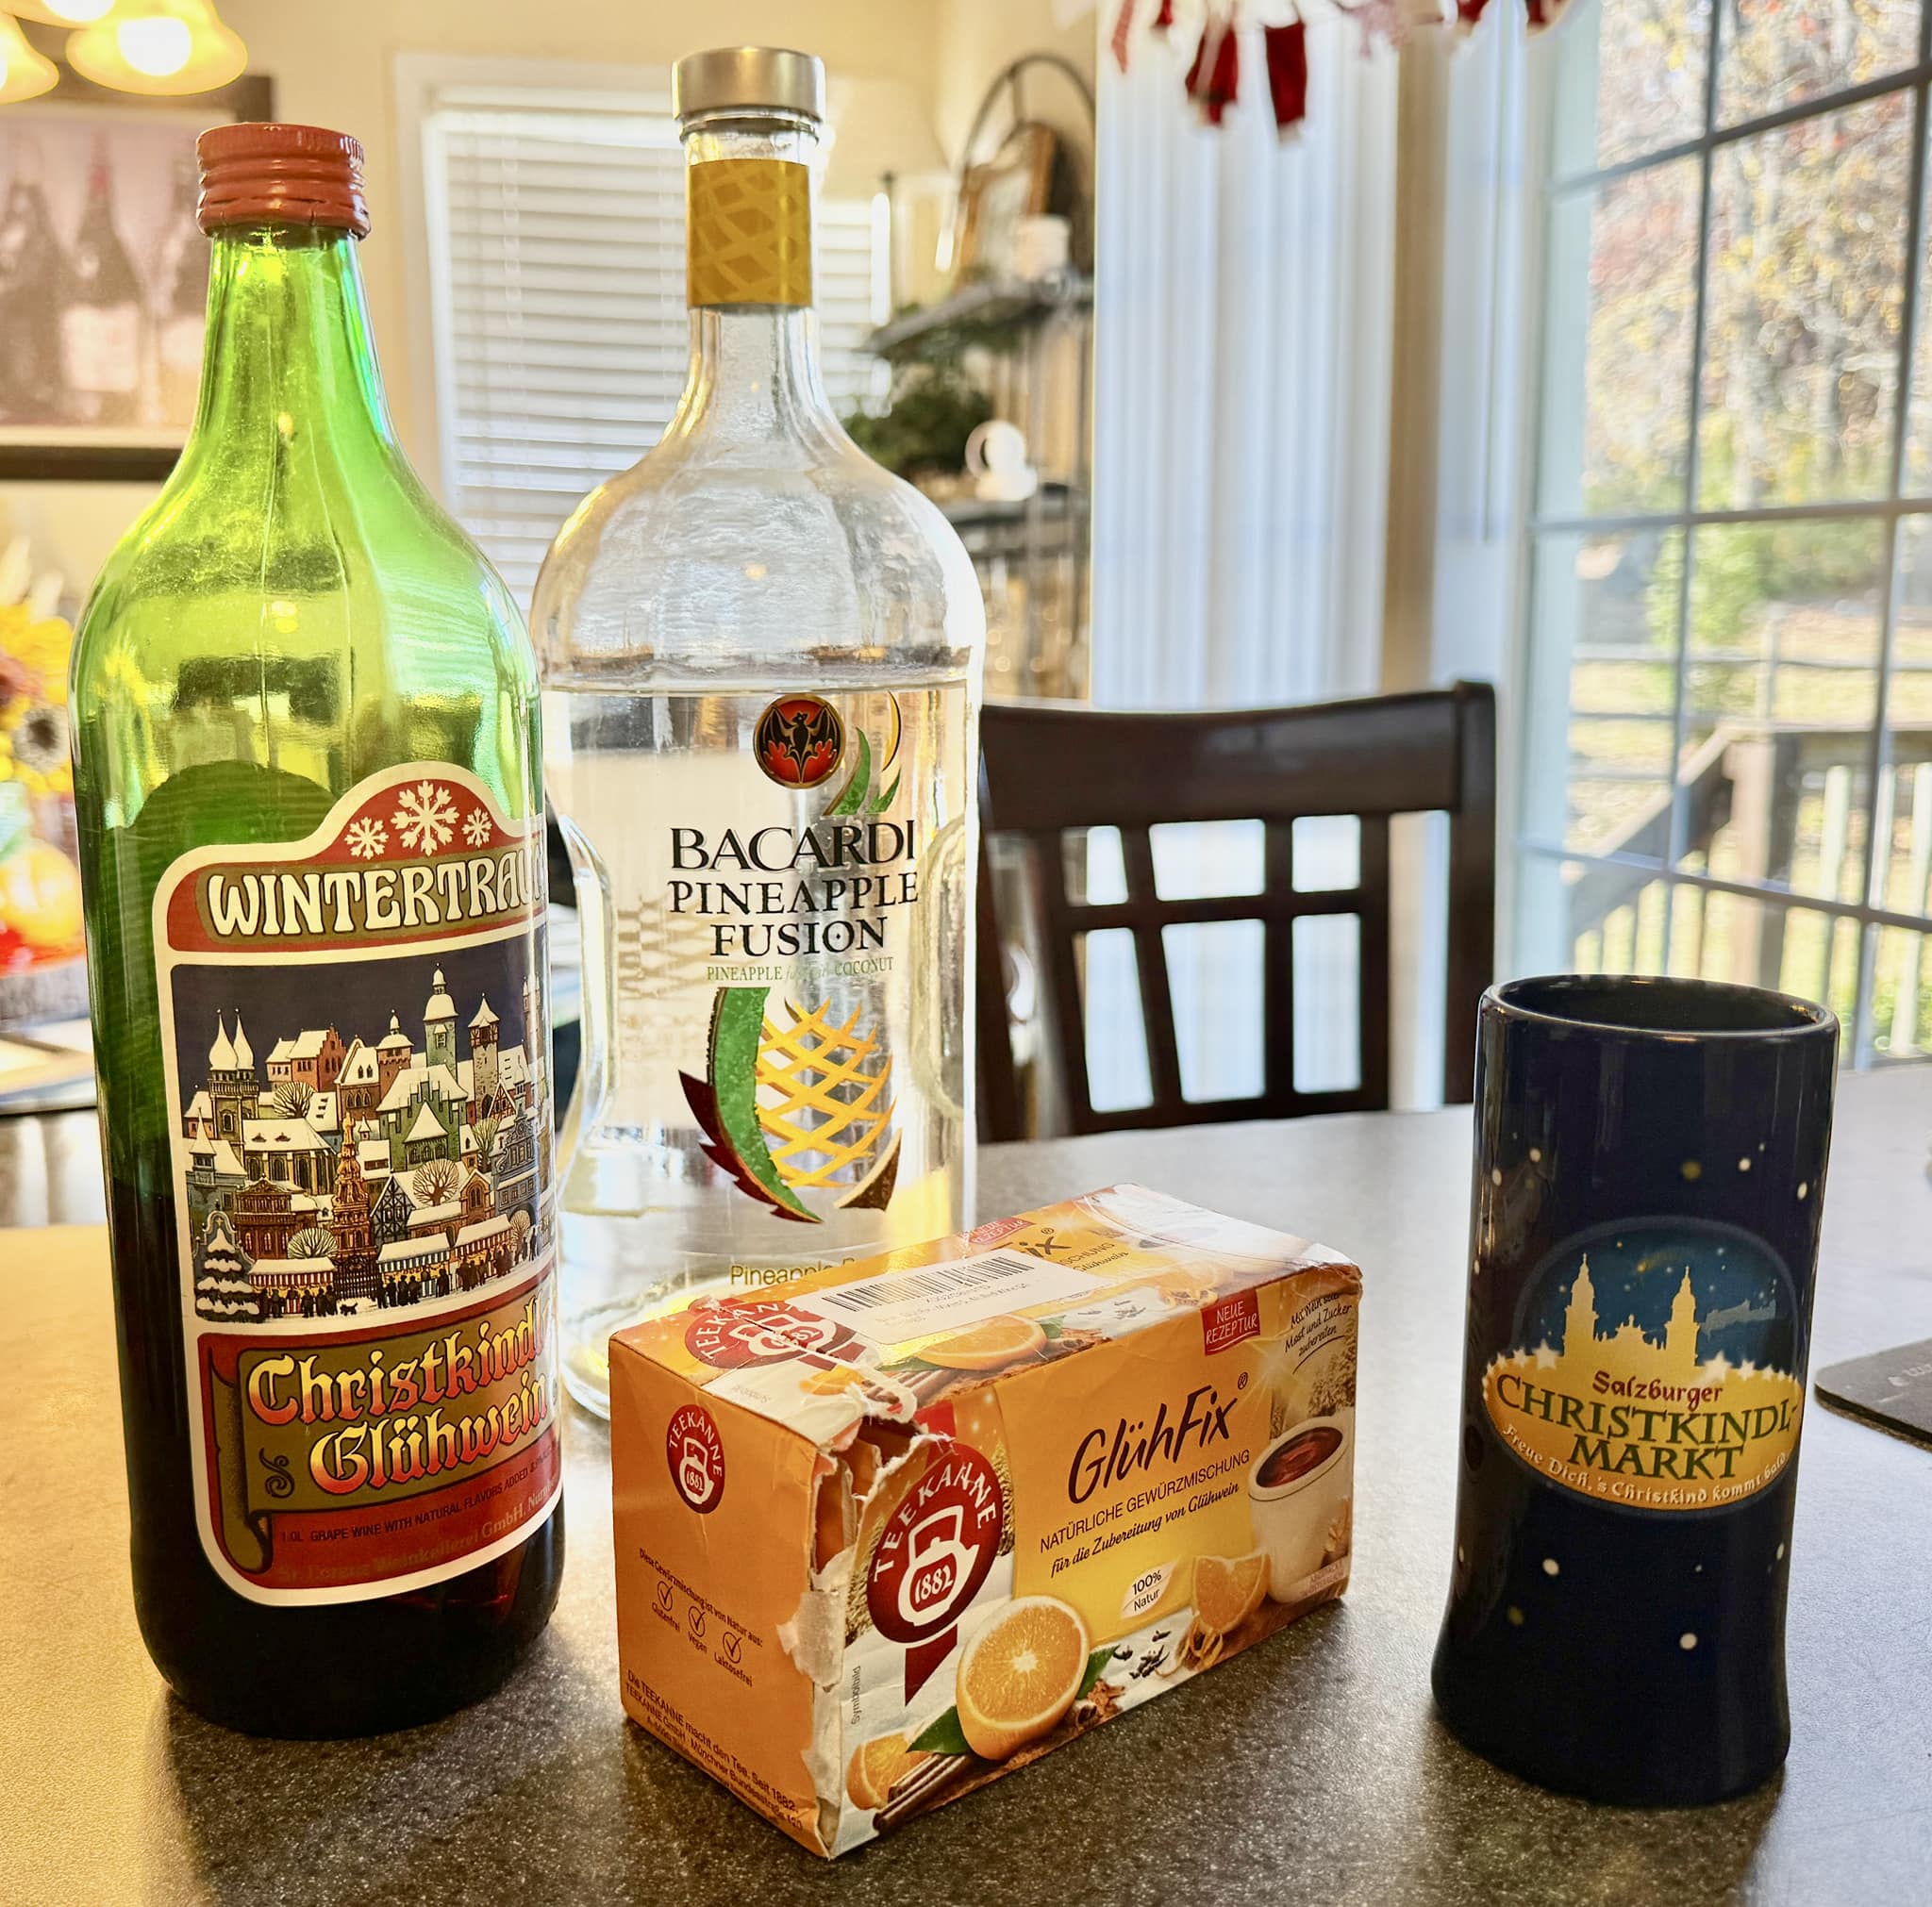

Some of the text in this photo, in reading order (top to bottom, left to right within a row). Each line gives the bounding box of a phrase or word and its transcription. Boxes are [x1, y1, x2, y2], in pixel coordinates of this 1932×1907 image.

[670, 819, 915, 872] BACARDI
[667, 871, 919, 916] PINEAPPLE
[709, 917, 888, 957] FUSION
[707, 965, 783, 982] PINEAPPLE
[834, 956, 894, 977] COCONUT
[1205, 1312, 1259, 1345] REZEPTUR
[1215, 1300, 1245, 1324] NEUE
[1306, 1312, 1322, 1335] und
[1323, 1302, 1353, 1323] Zucker
[1591, 1369, 1724, 1413] Salzburger
[308, 1369, 549, 1497] Glühwein
[668, 1411, 724, 1477] TEEKANNE
[1502, 1423, 1544, 1465] Freue
[1610, 1481, 1708, 1505] Christkind
[1712, 1473, 1762, 1502] kommt
[1566, 1434, 1744, 1481] MARKT
[310, 1527, 349, 1542] GRAPE
[351, 1523, 382, 1538] WINE
[384, 1516, 412, 1533] WITH
[414, 1503, 462, 1526] NATURAL
[464, 1482, 503, 1510] FLAVORS
[504, 1468, 528, 1491] ADDED
[873, 1460, 998, 1584] TEEKANNE
[1040, 1449, 1251, 1553] NATÜRLICHE GEWÜRZMISCHUNG
[1050, 1481, 1240, 1578] für die Zubereitung von Glühwein
[915, 1564, 955, 1605] 1882
[1131, 1569, 1163, 1596] 100%
[1132, 1586, 1161, 1613] Natur
[688, 1630, 708, 1654] Vegan
[713, 1607, 726, 1624] von
[726, 1614, 747, 1637] Natur
[714, 1650, 754, 1688] Laktosefrei
[625, 1681, 663, 1723] TEEKANNE
[641, 1679, 685, 1727] TEEKANNE
[685, 1721, 712, 1749] macht
[712, 1743, 730, 1765] den
[751, 1770, 772, 1797] Seit
